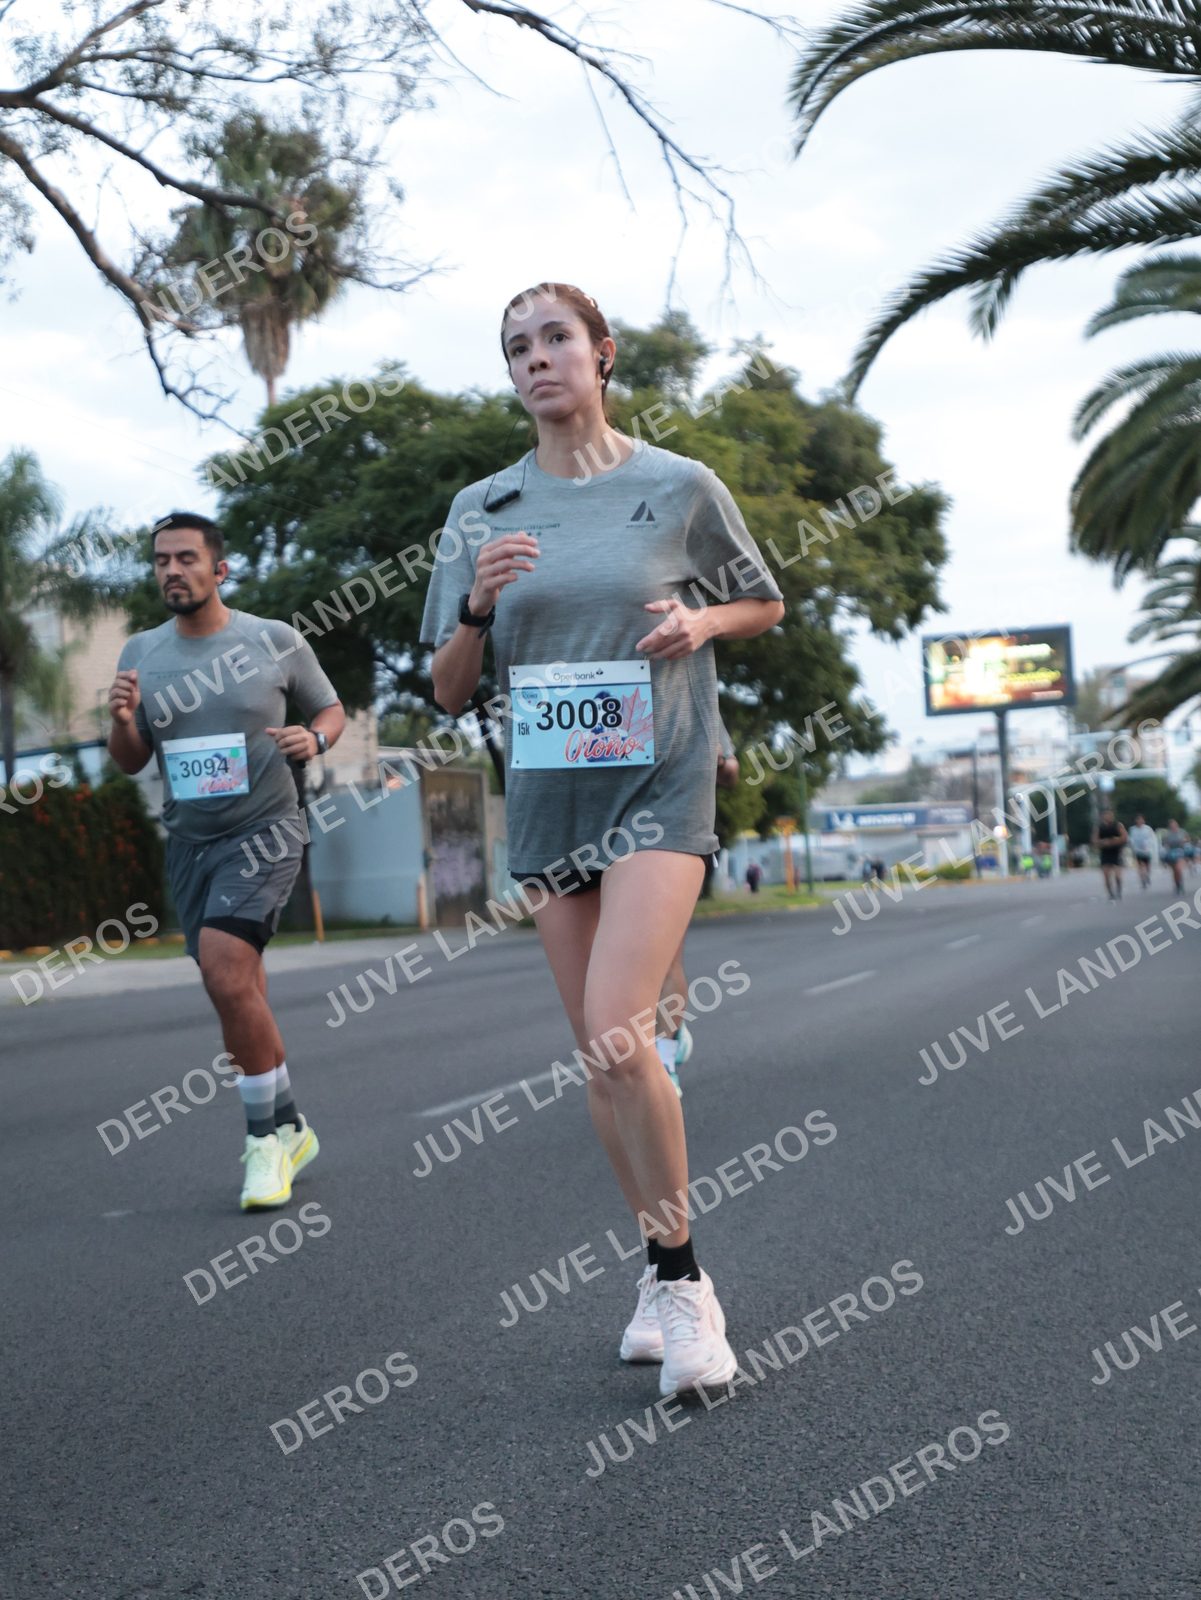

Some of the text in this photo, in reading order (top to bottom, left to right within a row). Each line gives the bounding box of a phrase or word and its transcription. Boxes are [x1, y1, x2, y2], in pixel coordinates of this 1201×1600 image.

[536, 697, 623, 731] 3008
[517, 722, 530, 736] 15k
[179, 757, 229, 779] 3094
